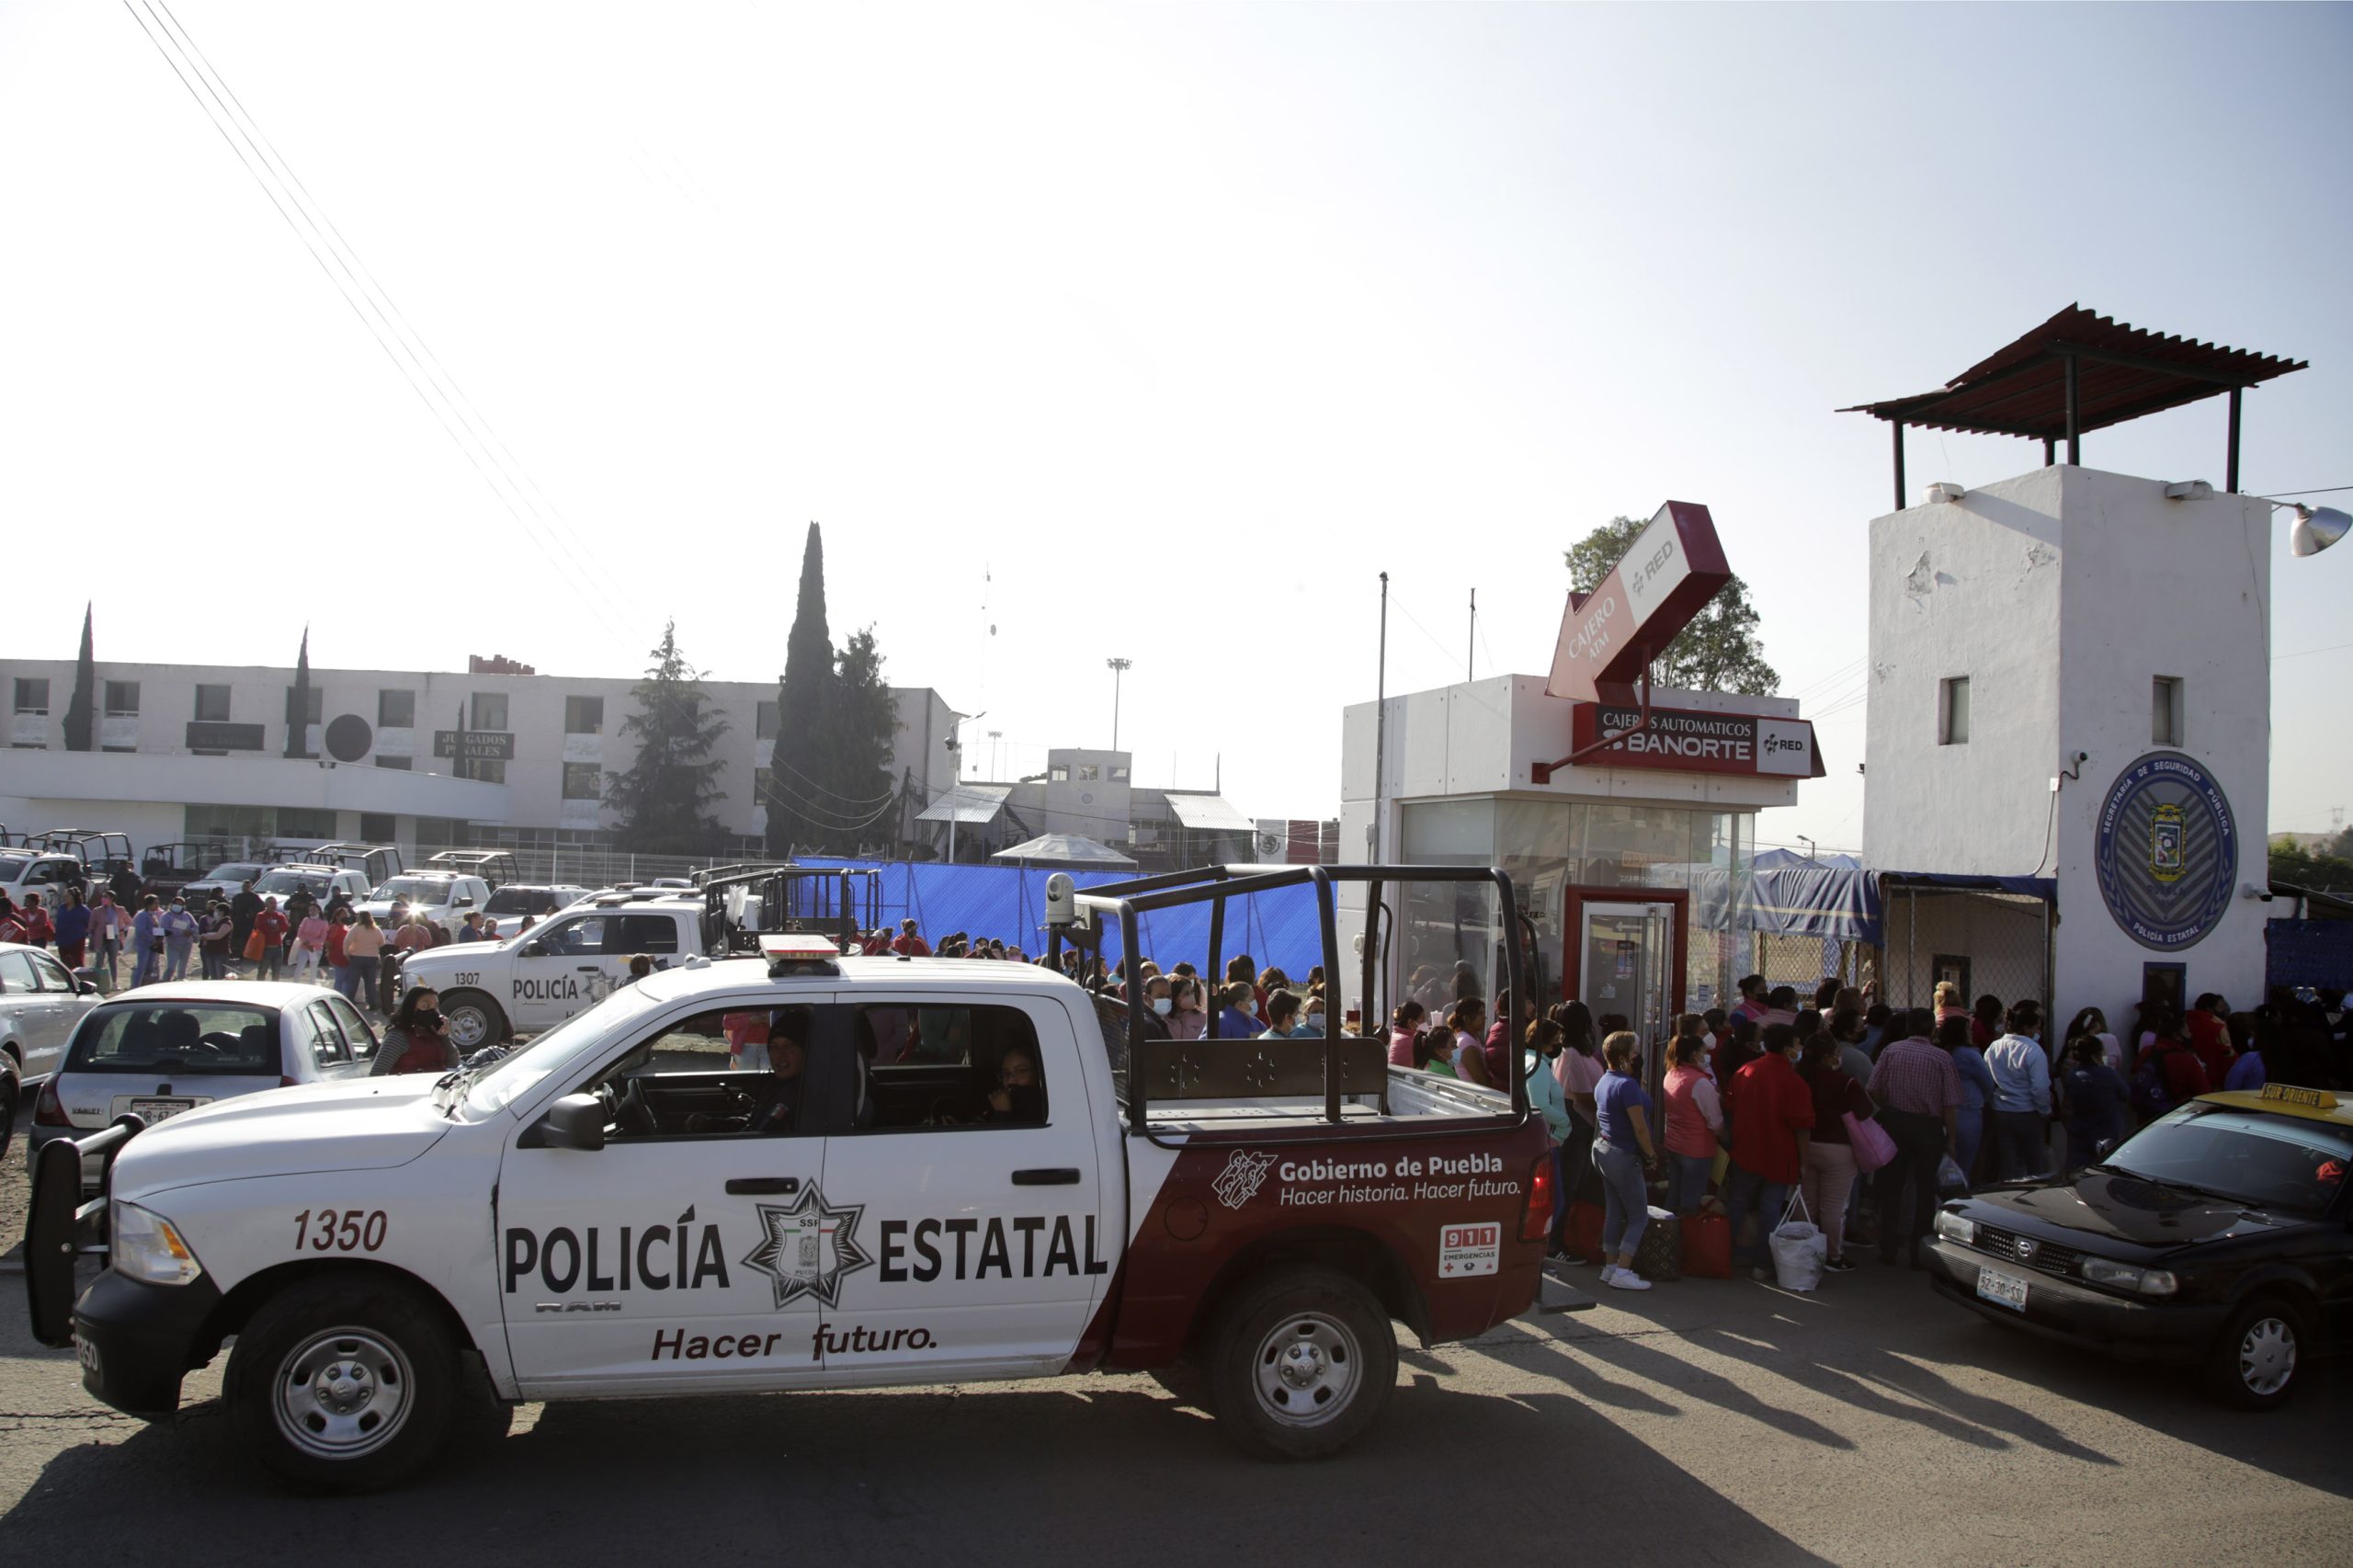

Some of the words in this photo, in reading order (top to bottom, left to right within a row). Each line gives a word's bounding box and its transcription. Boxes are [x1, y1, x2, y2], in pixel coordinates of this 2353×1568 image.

[1644, 540, 1674, 581] RED
[1568, 597, 1615, 659] CAJERO
[1588, 631, 1609, 662] ATM
[1603, 712, 1657, 729] CAJERS
[1660, 719, 1751, 736] AUTOMATICOS
[442, 733, 506, 745] JUGADOS
[1628, 733, 1751, 760] BANORTE
[2137, 766, 2148, 778] DE
[2154, 761, 2200, 782] SEGURIDAD
[2206, 788, 2230, 836] PÚBLICA
[2133, 922, 2164, 942] POLICÍA
[2167, 925, 2200, 943] ESTATAL
[454, 972, 480, 985] 1307
[513, 973, 579, 999] POLICÍA
[2264, 1085, 2282, 1099] SUR
[2282, 1088, 2320, 1106] ORIENTE
[1279, 1158, 1387, 1182] Gobierno
[1394, 1156, 1422, 1177] de
[1429, 1153, 1503, 1176] Puebla
[1279, 1187, 1336, 1206] Hacer
[1338, 1184, 1410, 1203] historia.
[1414, 1181, 1467, 1199] Hacer
[1467, 1178, 1522, 1201] futuro.
[294, 1209, 388, 1252] 1350
[506, 1203, 731, 1294] POLICÍA
[880, 1214, 1108, 1283] ESTATAL
[1443, 1251, 1495, 1262] EMERGENCIAS
[536, 1301, 621, 1313] RAM
[652, 1328, 781, 1360] Hacer
[813, 1323, 938, 1361] futuro.
